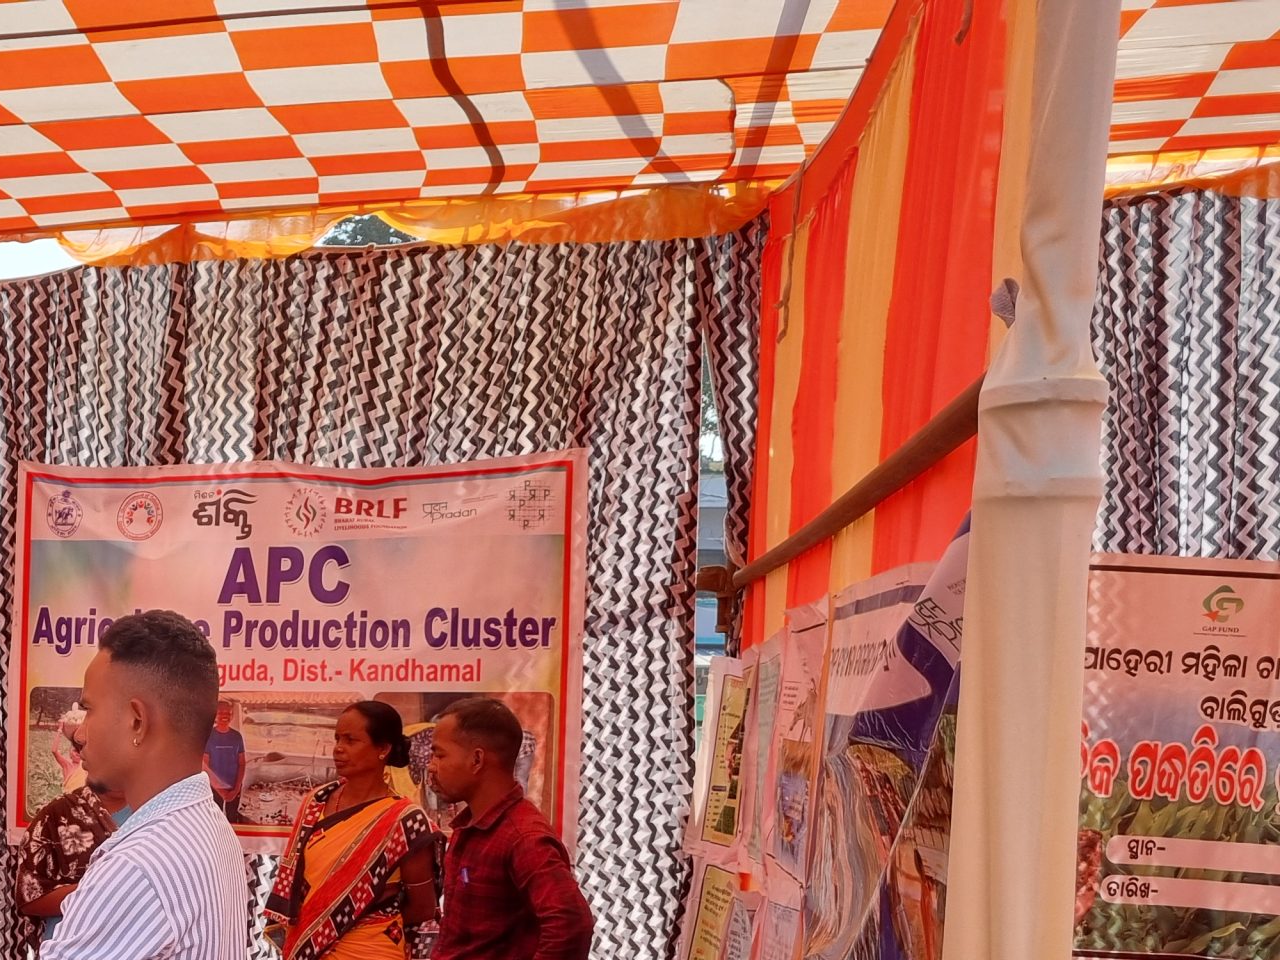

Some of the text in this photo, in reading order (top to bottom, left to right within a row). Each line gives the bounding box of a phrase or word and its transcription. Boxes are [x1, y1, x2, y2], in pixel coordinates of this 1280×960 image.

[334, 497, 408, 519] BRLF
[217, 544, 352, 605] APC
[32, 606, 556, 655] Agrice Production Cluster
[218, 658, 275, 686] guda,
[350, 658, 481, 682] Kandhamal
[1181, 644, 1248, 682] ମହିଳା
[1106, 877, 1159, 898] ତାରିଖ-
